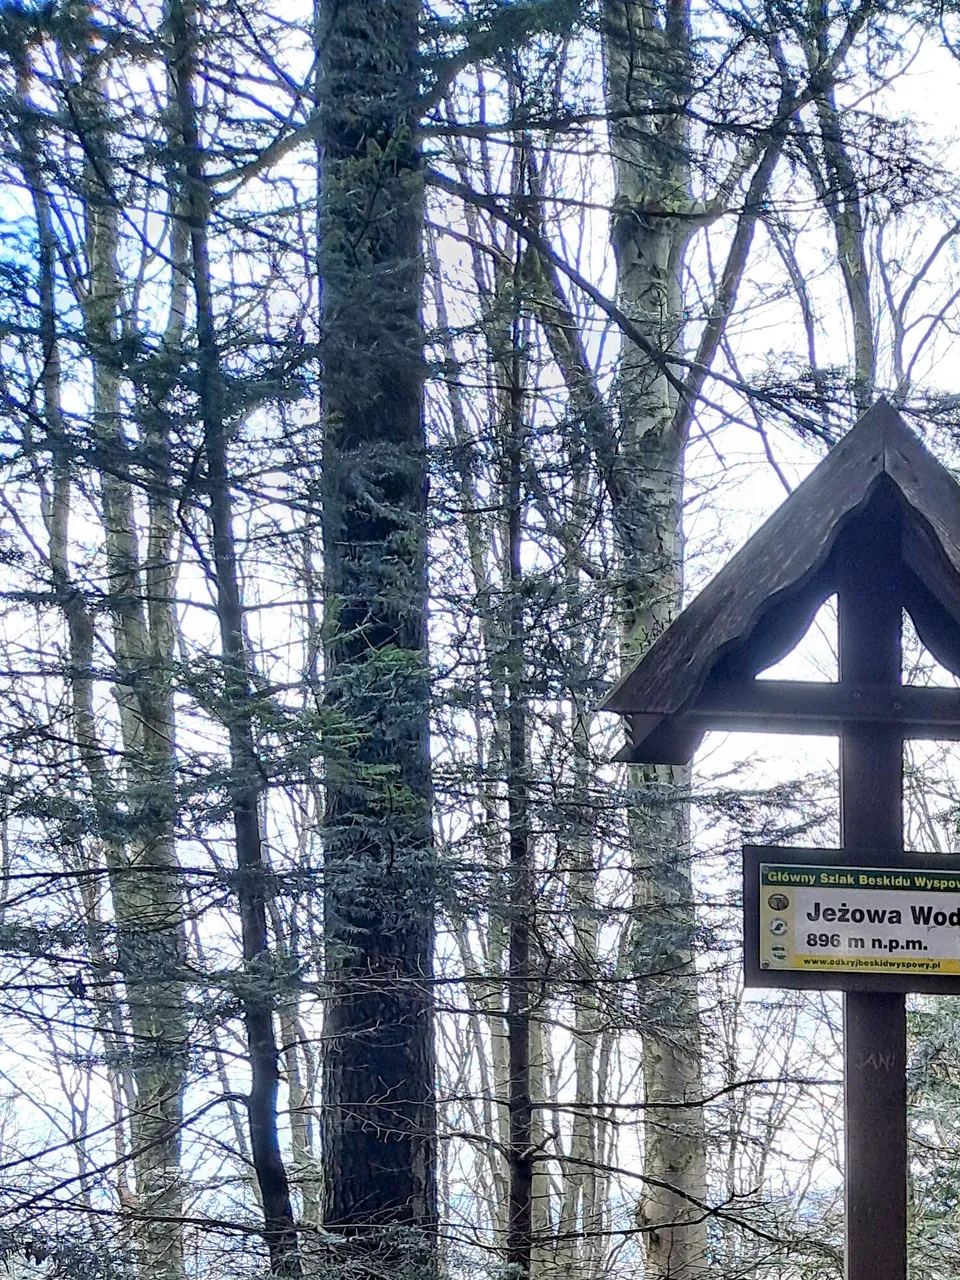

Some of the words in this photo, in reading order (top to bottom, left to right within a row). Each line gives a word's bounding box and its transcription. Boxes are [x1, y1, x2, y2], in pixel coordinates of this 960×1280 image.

[767, 871, 816, 885] Główny
[820, 873, 855, 885] Szlak
[859, 875, 910, 887] Beskidu
[806, 902, 902, 925] Jeżowa
[806, 933, 841, 948] 896
[848, 936, 865, 949] m
[871, 937, 928, 952] n.p.m.
[803, 957, 941, 970] www.odkryjbeskidwyspowy.pl
